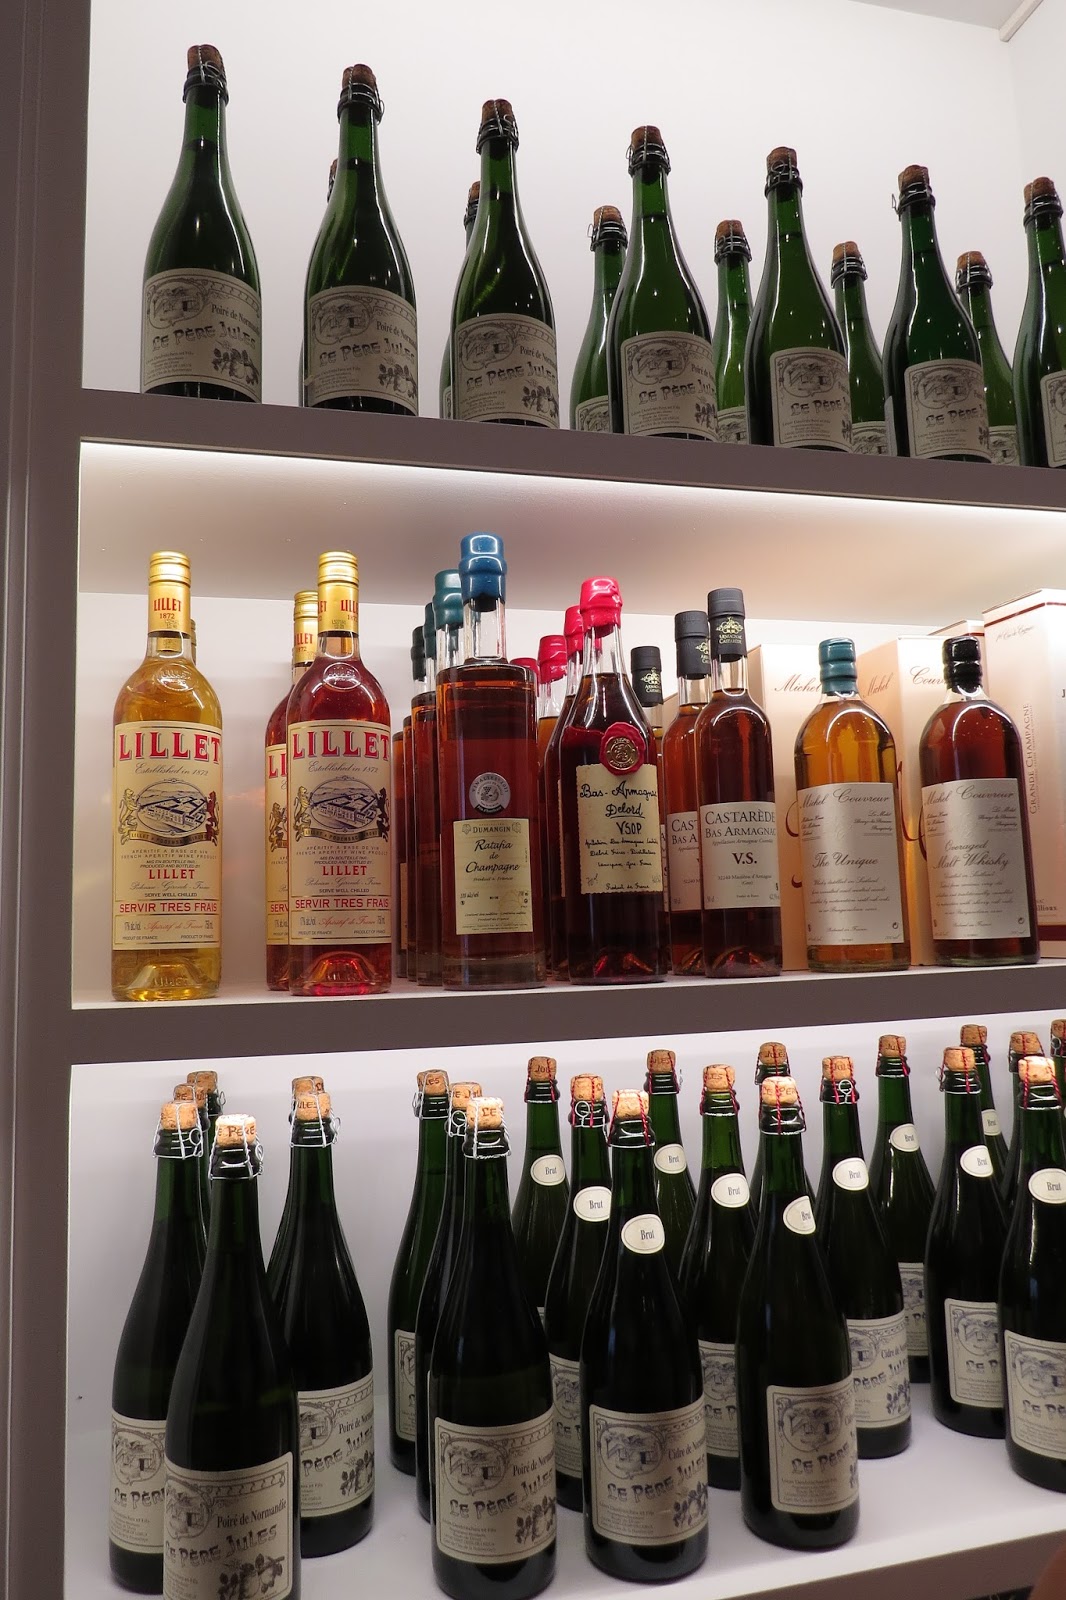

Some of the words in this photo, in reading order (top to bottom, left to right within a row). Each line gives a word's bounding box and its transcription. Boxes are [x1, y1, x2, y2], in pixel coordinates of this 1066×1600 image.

[154, 598, 182, 612] LILLET
[119, 731, 220, 765] LILLET
[293, 730, 389, 761] LILLET
[135, 762, 183, 775] Established
[192, 768, 209, 776] 1872
[308, 761, 351, 773] Established
[801, 793, 829, 809] Michel
[833, 788, 890, 803] Couvreur
[956, 785, 1014, 800] Couvreur
[605, 802, 644, 817] Delord
[705, 808, 775, 825] CASTARÈDE
[473, 826, 511, 834] DUMANGIN
[705, 828, 722, 838] BAS
[724, 826, 776, 837] ARMAGNAC
[474, 839, 514, 852] Ratafia
[489, 852, 500, 860] de
[732, 851, 758, 865] V.S.
[813, 852, 830, 868] The
[832, 852, 879, 868] Unique
[962, 851, 1009, 871] Whisky
[322, 865, 367, 876] LILLET
[465, 861, 520, 874] Champagne
[149, 868, 195, 880] LILLET
[119, 903, 156, 913] SERVIR
[160, 902, 191, 912] TRES
[194, 902, 217, 912] FRAIS
[271, 903, 288, 913] SERV
[295, 899, 330, 909] SERVIR
[333, 898, 364, 908] TRES
[366, 898, 389, 908] FRAIS
[668, 1155, 680, 1163] Brut
[546, 1166, 557, 1174] Brut
[728, 1187, 741, 1196] Brut
[1047, 1181, 1061, 1191] Brut
[589, 1200, 604, 1209] Brut
[640, 1230, 655, 1240] Brut
[217, 1513, 239, 1528] Poiré
[250, 1499, 287, 1522] Normandie
